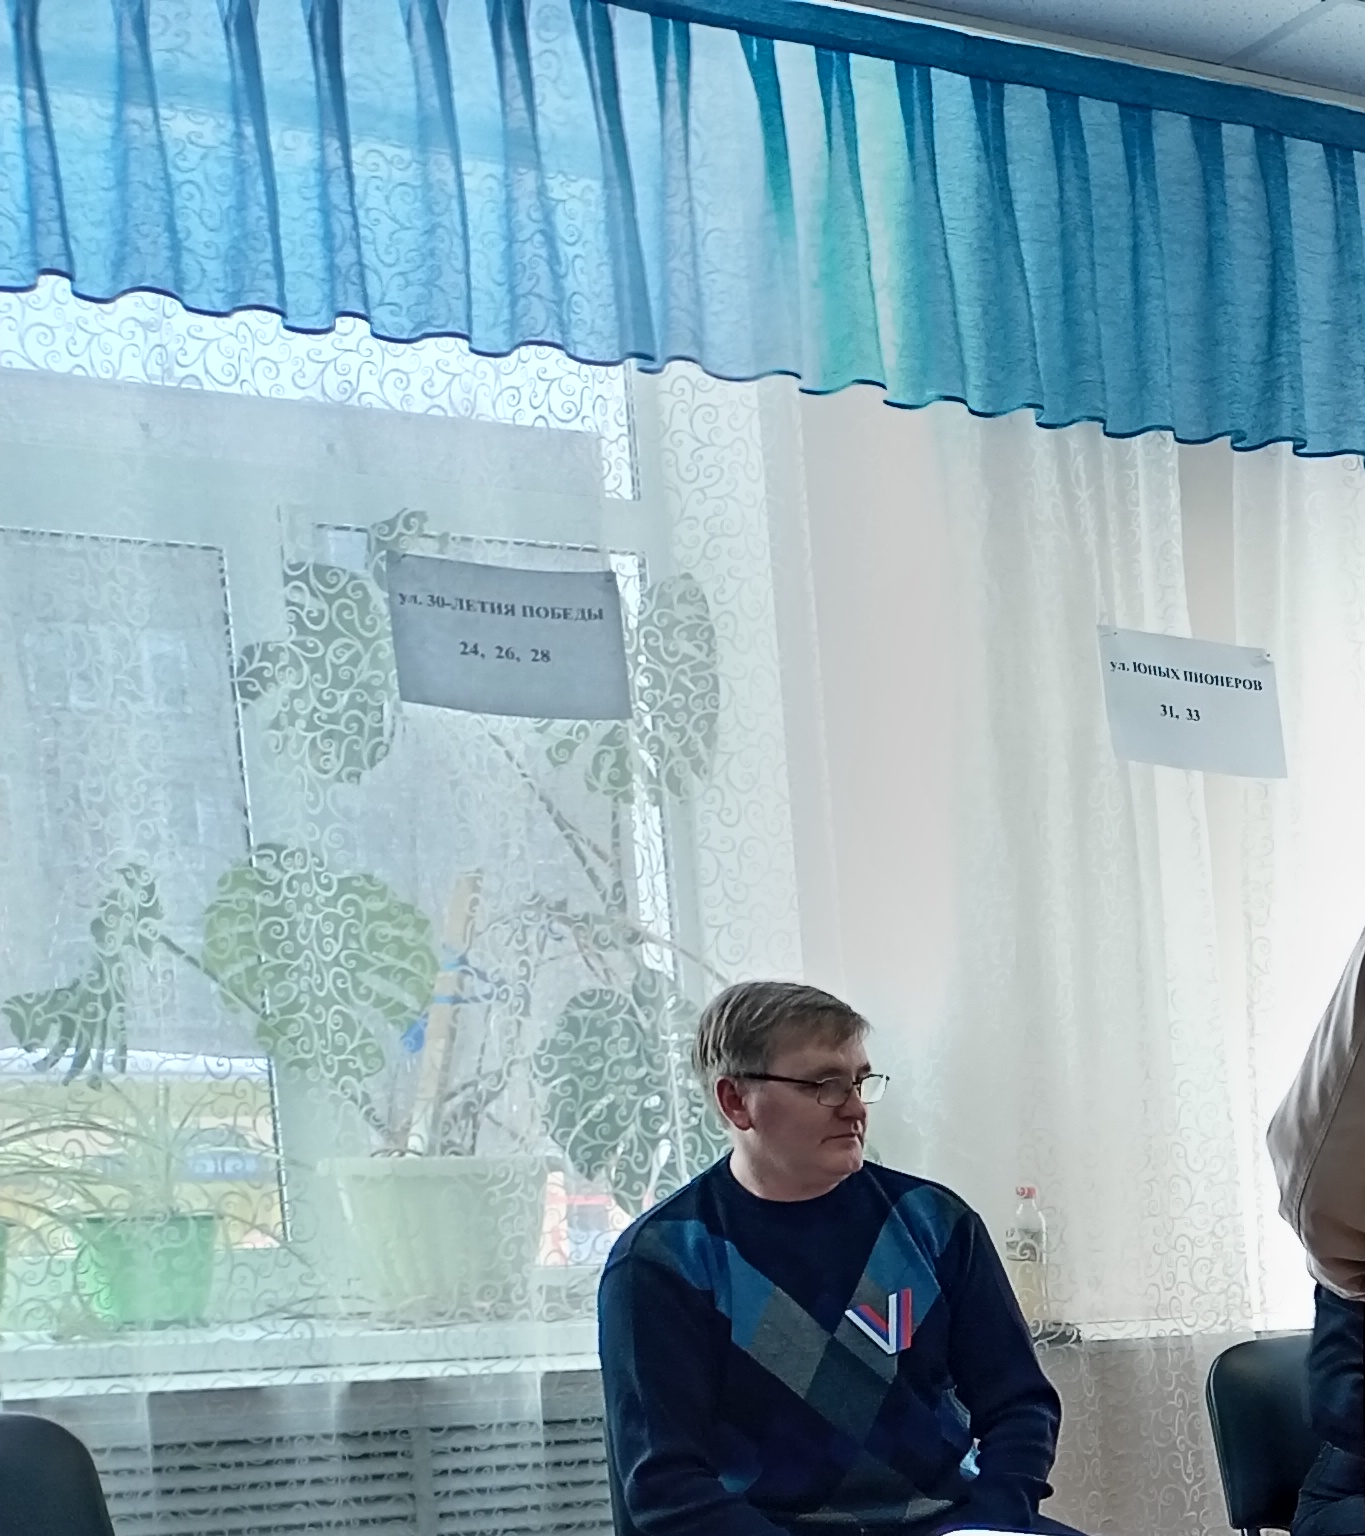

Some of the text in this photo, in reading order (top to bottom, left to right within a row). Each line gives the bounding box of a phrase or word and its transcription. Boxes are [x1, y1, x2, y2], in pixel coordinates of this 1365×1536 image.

[398, 592, 604, 622] ул. 30-ЛЕТИЯ ПОБЕДЫ
[459, 641, 552, 663] 24, 26, 28
[1109, 661, 1263, 691] ул. ЮНЫХ ПИОНЕРОВ
[1185, 708, 1201, 722] 33
